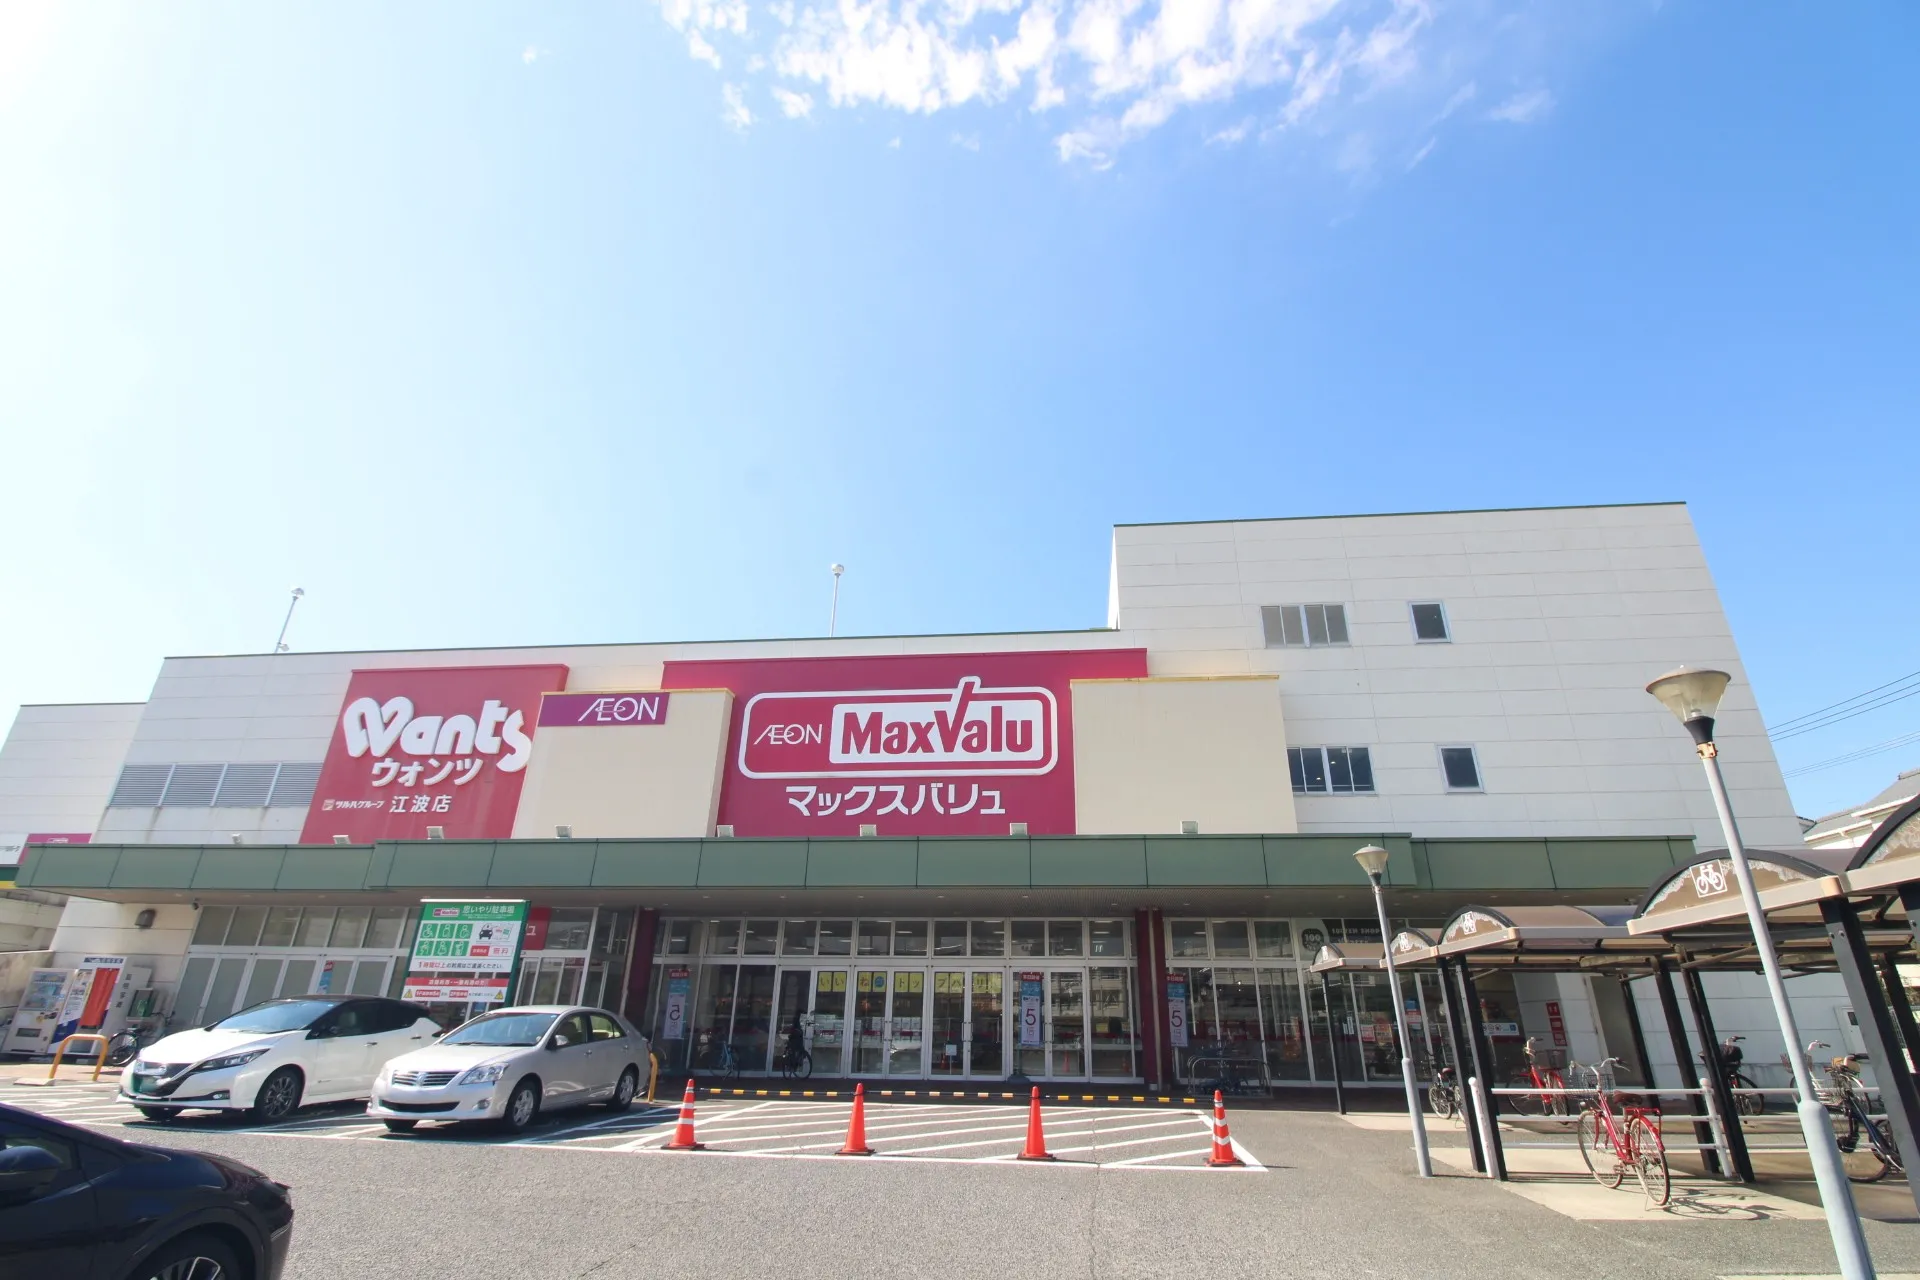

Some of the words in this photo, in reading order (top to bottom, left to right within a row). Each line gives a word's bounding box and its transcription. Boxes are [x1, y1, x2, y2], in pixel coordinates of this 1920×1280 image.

[342, 695, 533, 773] Wants
[841, 680, 1034, 756] MaxValu
[371, 756, 484, 787] ウォンツ
[389, 794, 452, 813] 江波店
[785, 783, 1006, 817] マックスバリュ
